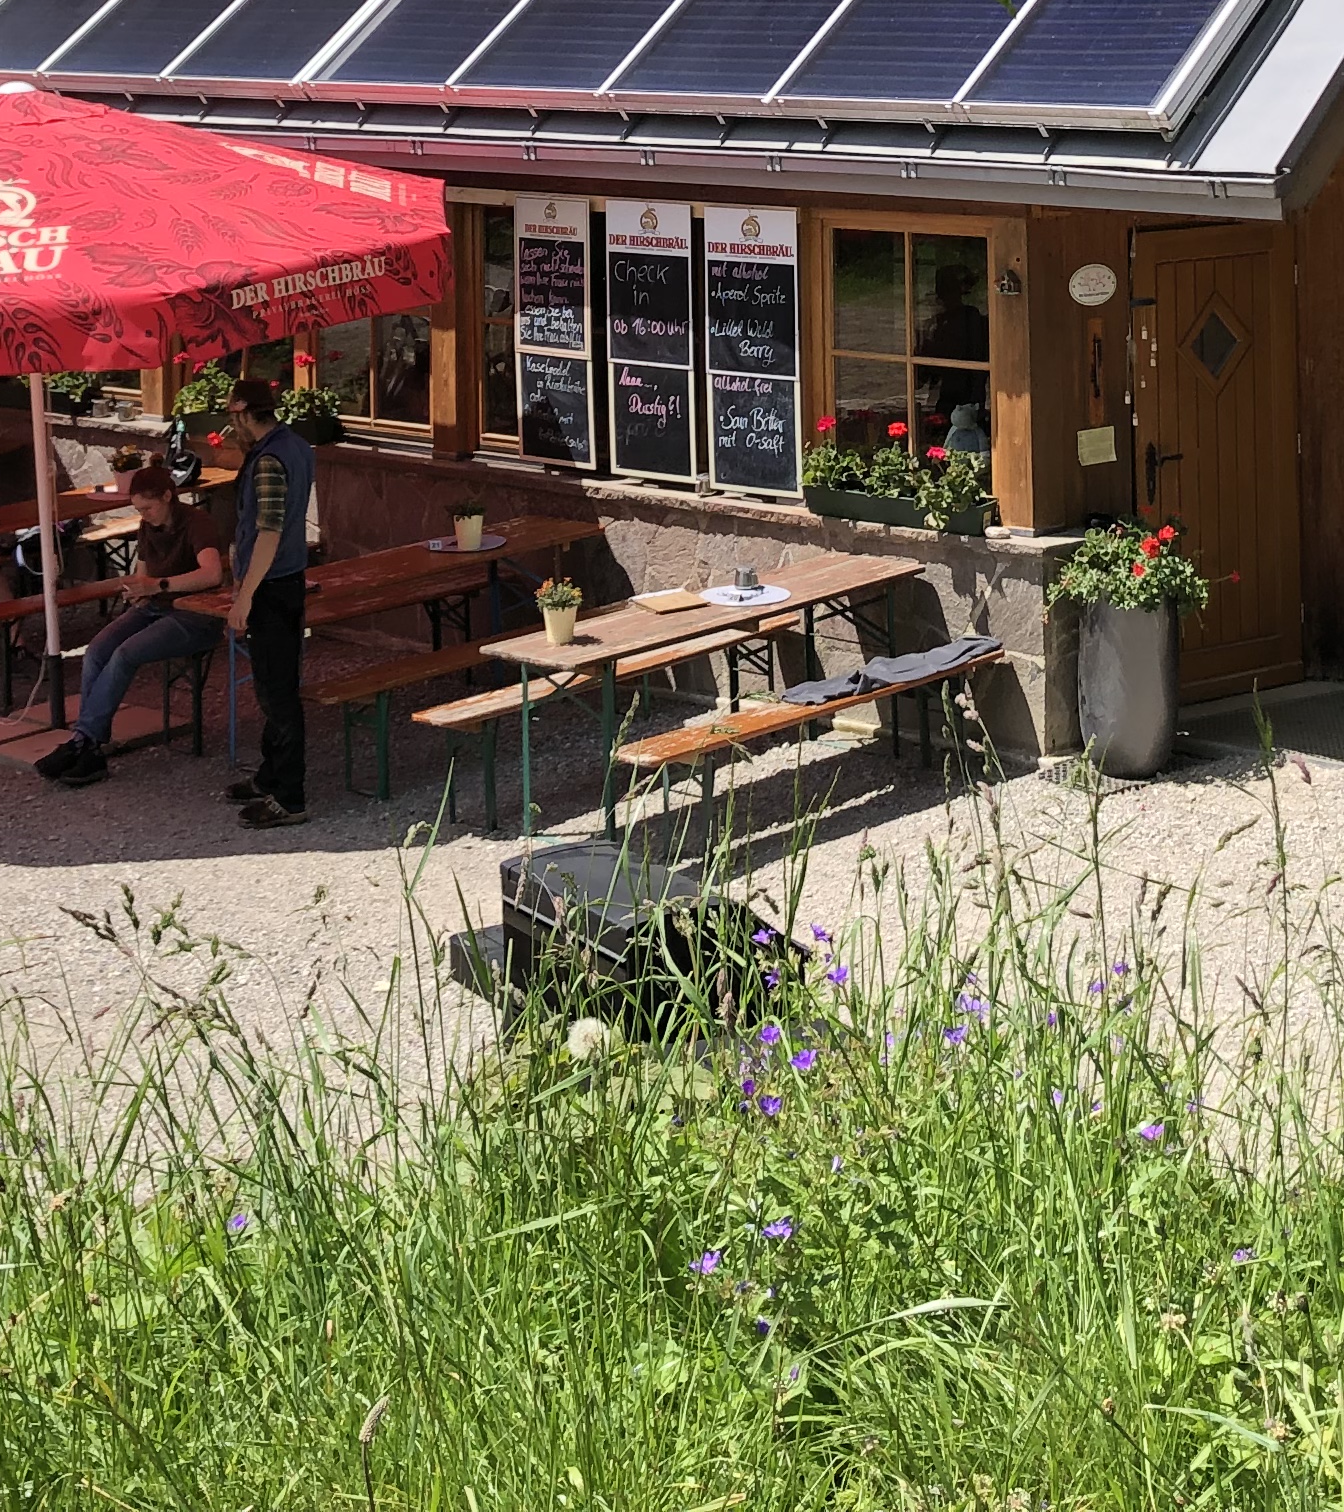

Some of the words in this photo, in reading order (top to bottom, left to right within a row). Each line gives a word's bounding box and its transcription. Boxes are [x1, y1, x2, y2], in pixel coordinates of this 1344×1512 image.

[609, 234, 627, 245] DER
[707, 242, 727, 253] DER
[615, 260, 669, 284] Check
[231, 283, 270, 309] DER
[271, 255, 387, 298] HIRSCHBRÄU
[633, 284, 649, 305] in
[520, 326, 533, 339] Sie
[632, 318, 665, 335] 16:00
[721, 405, 748, 429] San
[719, 431, 736, 447] mit
